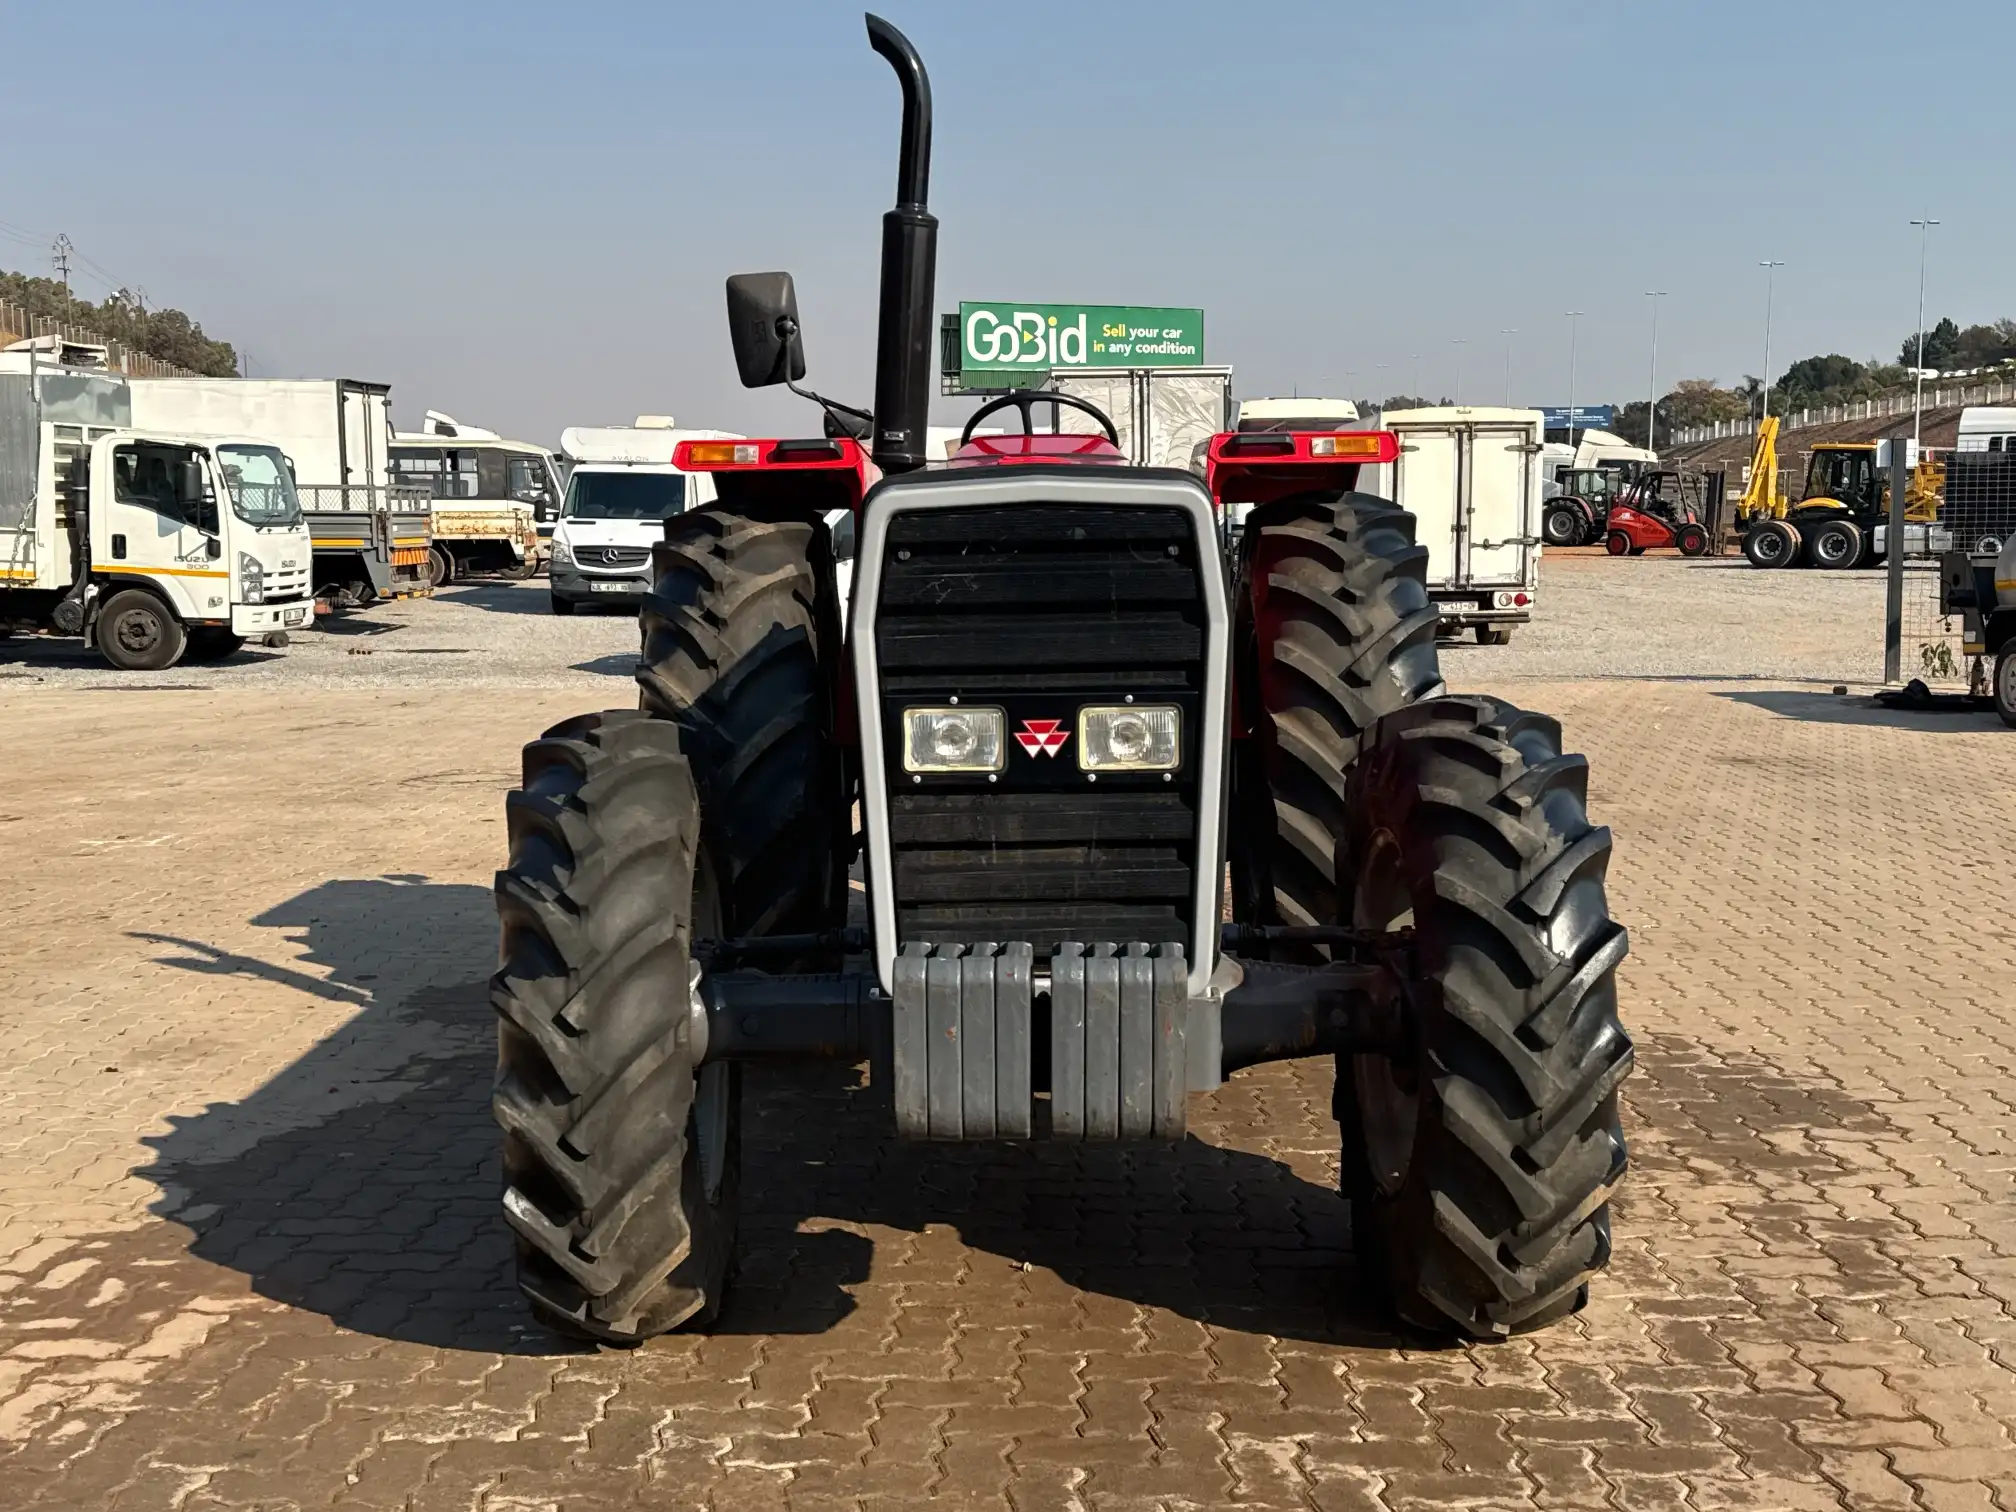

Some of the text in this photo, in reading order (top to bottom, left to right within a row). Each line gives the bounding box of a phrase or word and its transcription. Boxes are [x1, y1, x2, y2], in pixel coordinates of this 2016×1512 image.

[967, 310, 1087, 364] GoBid
[1102, 324, 1183, 341] Sell your car
[1093, 340, 1196, 357] in any condition
